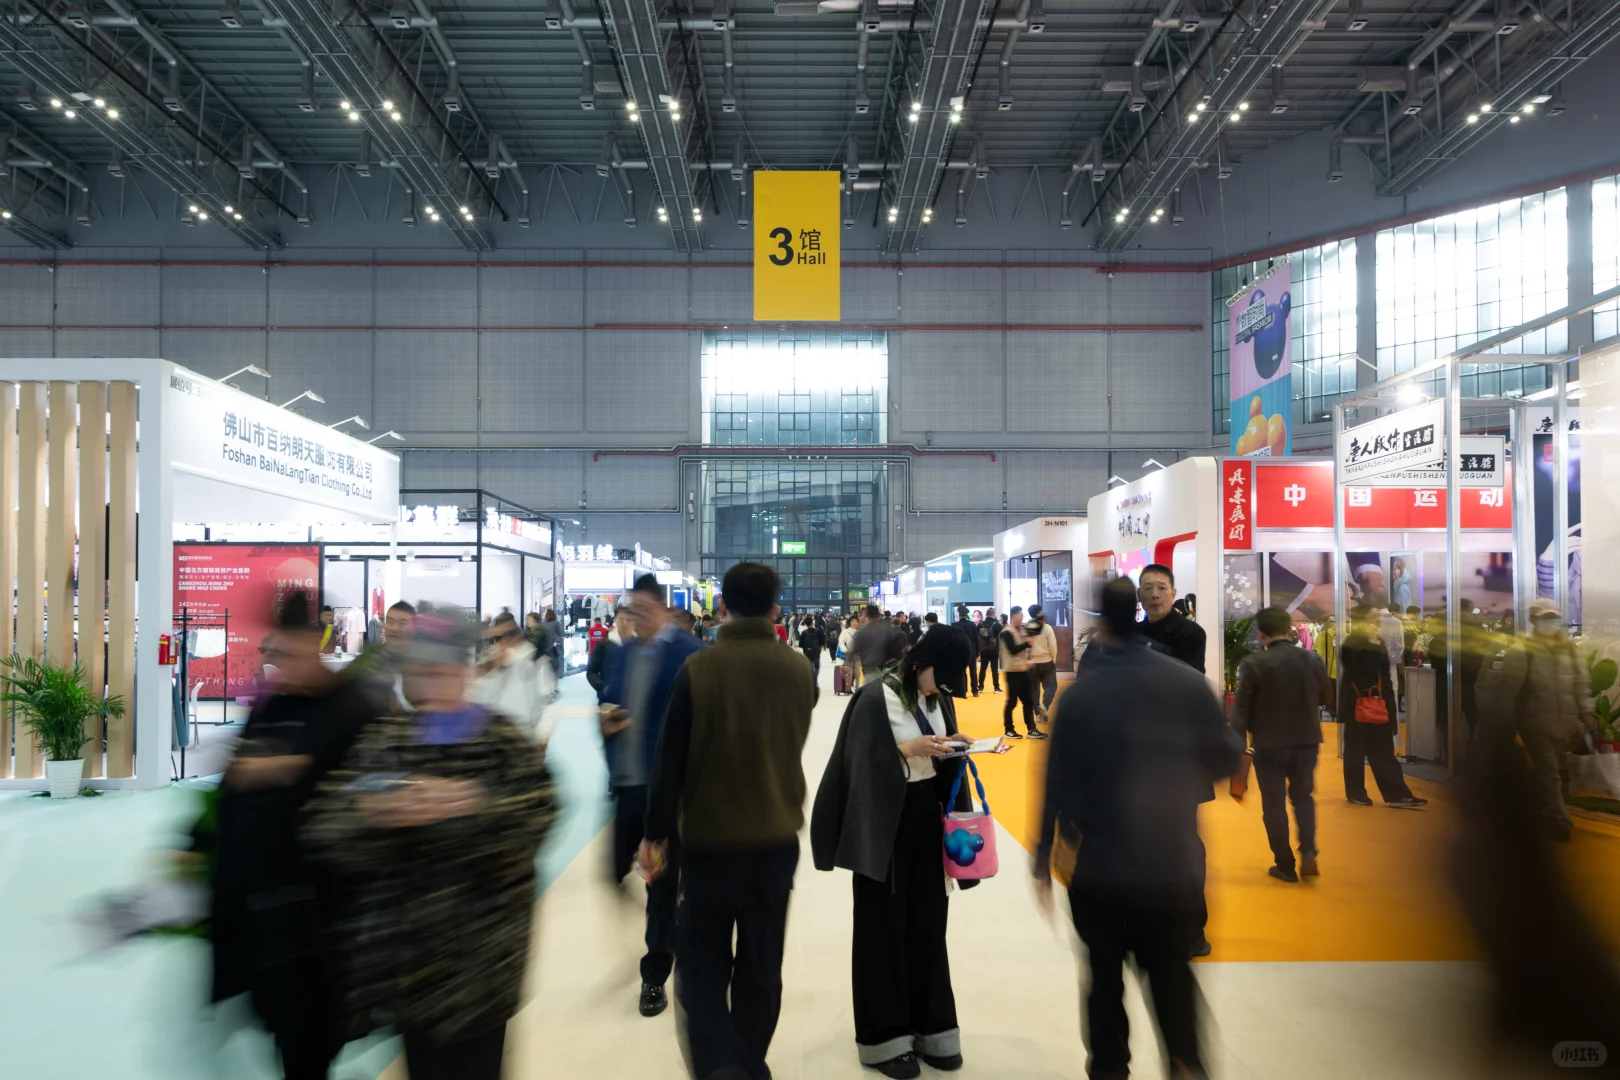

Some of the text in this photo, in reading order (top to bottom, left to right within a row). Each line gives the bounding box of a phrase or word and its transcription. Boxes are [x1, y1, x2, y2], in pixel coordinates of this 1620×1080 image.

[768, 227, 821, 266] 3 馆
[797, 252, 826, 265] Hall
[1252, 314, 1273, 333] FASHION
[222, 409, 373, 483] 佛山市百纳朗天服饰有限公司
[222, 443, 257, 467] Foshan
[259, 455, 320, 484] BaiNaLangTian
[321, 474, 350, 497] Clothing
[277, 578, 314, 588] MING
